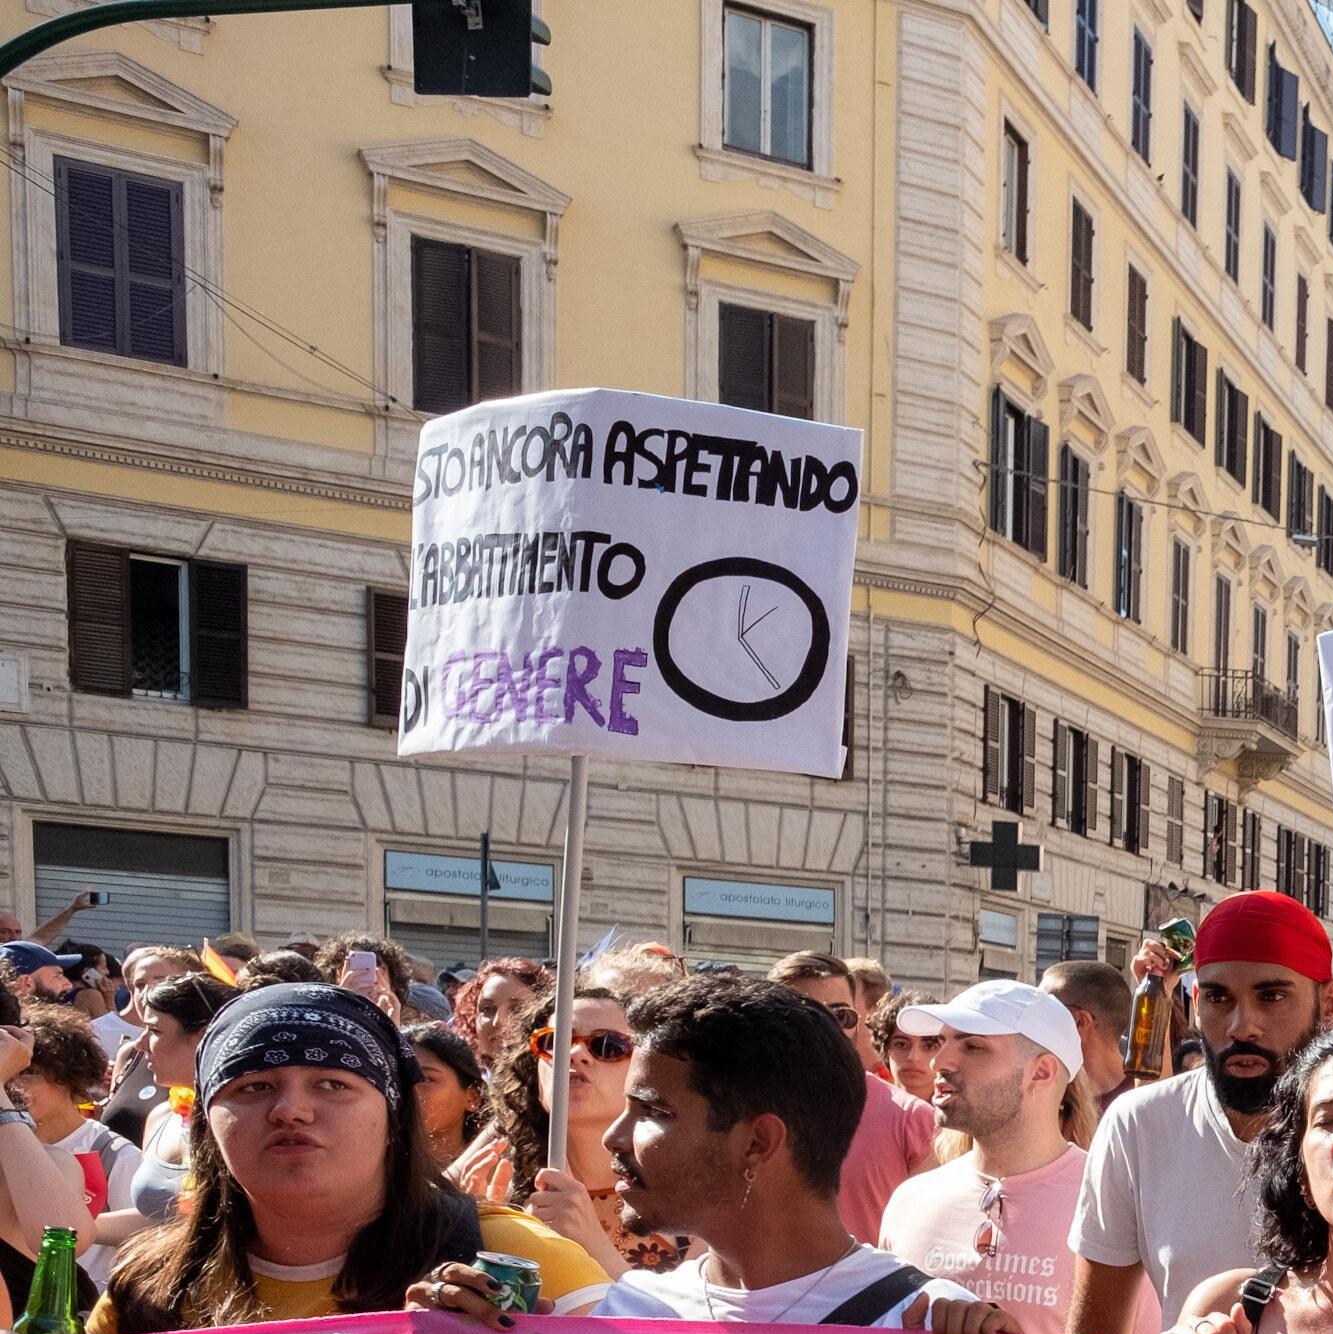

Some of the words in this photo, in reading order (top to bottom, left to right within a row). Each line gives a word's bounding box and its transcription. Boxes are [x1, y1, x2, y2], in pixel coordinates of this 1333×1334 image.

[414, 441, 468, 507] STO
[470, 411, 593, 490] ANCORA
[603, 420, 859, 514] ASPETTANDO
[403, 664, 428, 734] DI
[440, 645, 648, 736] GENERE
[720, 892, 781, 906] apostolato
[785, 895, 830, 910] liturgico
